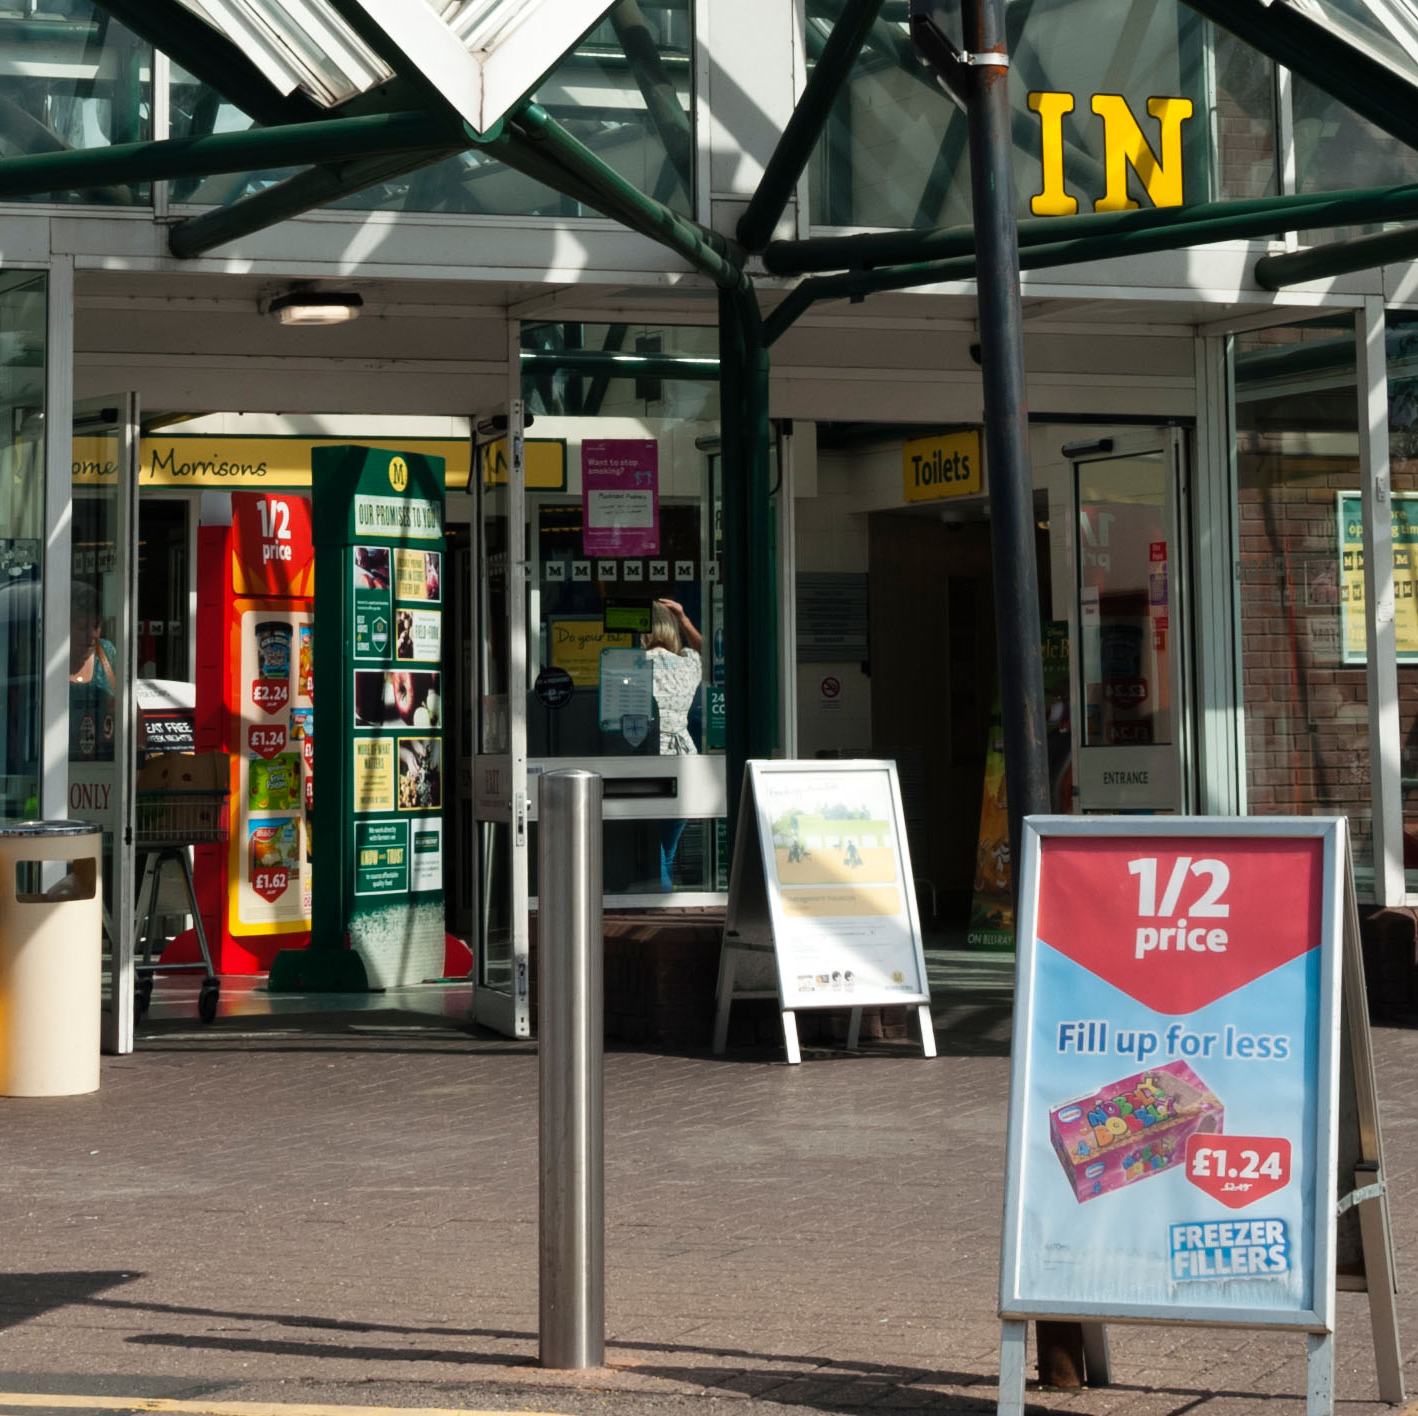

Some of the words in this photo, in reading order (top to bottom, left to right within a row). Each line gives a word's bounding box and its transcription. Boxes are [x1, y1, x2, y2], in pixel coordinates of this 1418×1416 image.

[1027, 91, 1194, 216] IN
[150, 447, 268, 478] Morrisons
[910, 449, 971, 488] Toilets
[256, 499, 292, 539] 1/2
[262, 539, 292, 565] price
[253, 686, 288, 701] £2.24
[165, 722, 193, 734] FREE
[251, 731, 284, 745] £1.24
[1103, 771, 1148, 785] ENTRANCE
[70, 783, 111, 810] ONLY
[256, 873, 286, 889] £1.62
[1128, 857, 1230, 918] 1/2
[1135, 918, 1228, 960] price
[1057, 1022, 1107, 1055] Fill
[1116, 1030, 1157, 1062] up
[1167, 1024, 1217, 1058] for
[1227, 1027, 1289, 1060] less
[1192, 1148, 1283, 1180] £1.24
[1173, 1220, 1286, 1251] FREEZER
[1174, 1245, 1288, 1277] FILLERS
